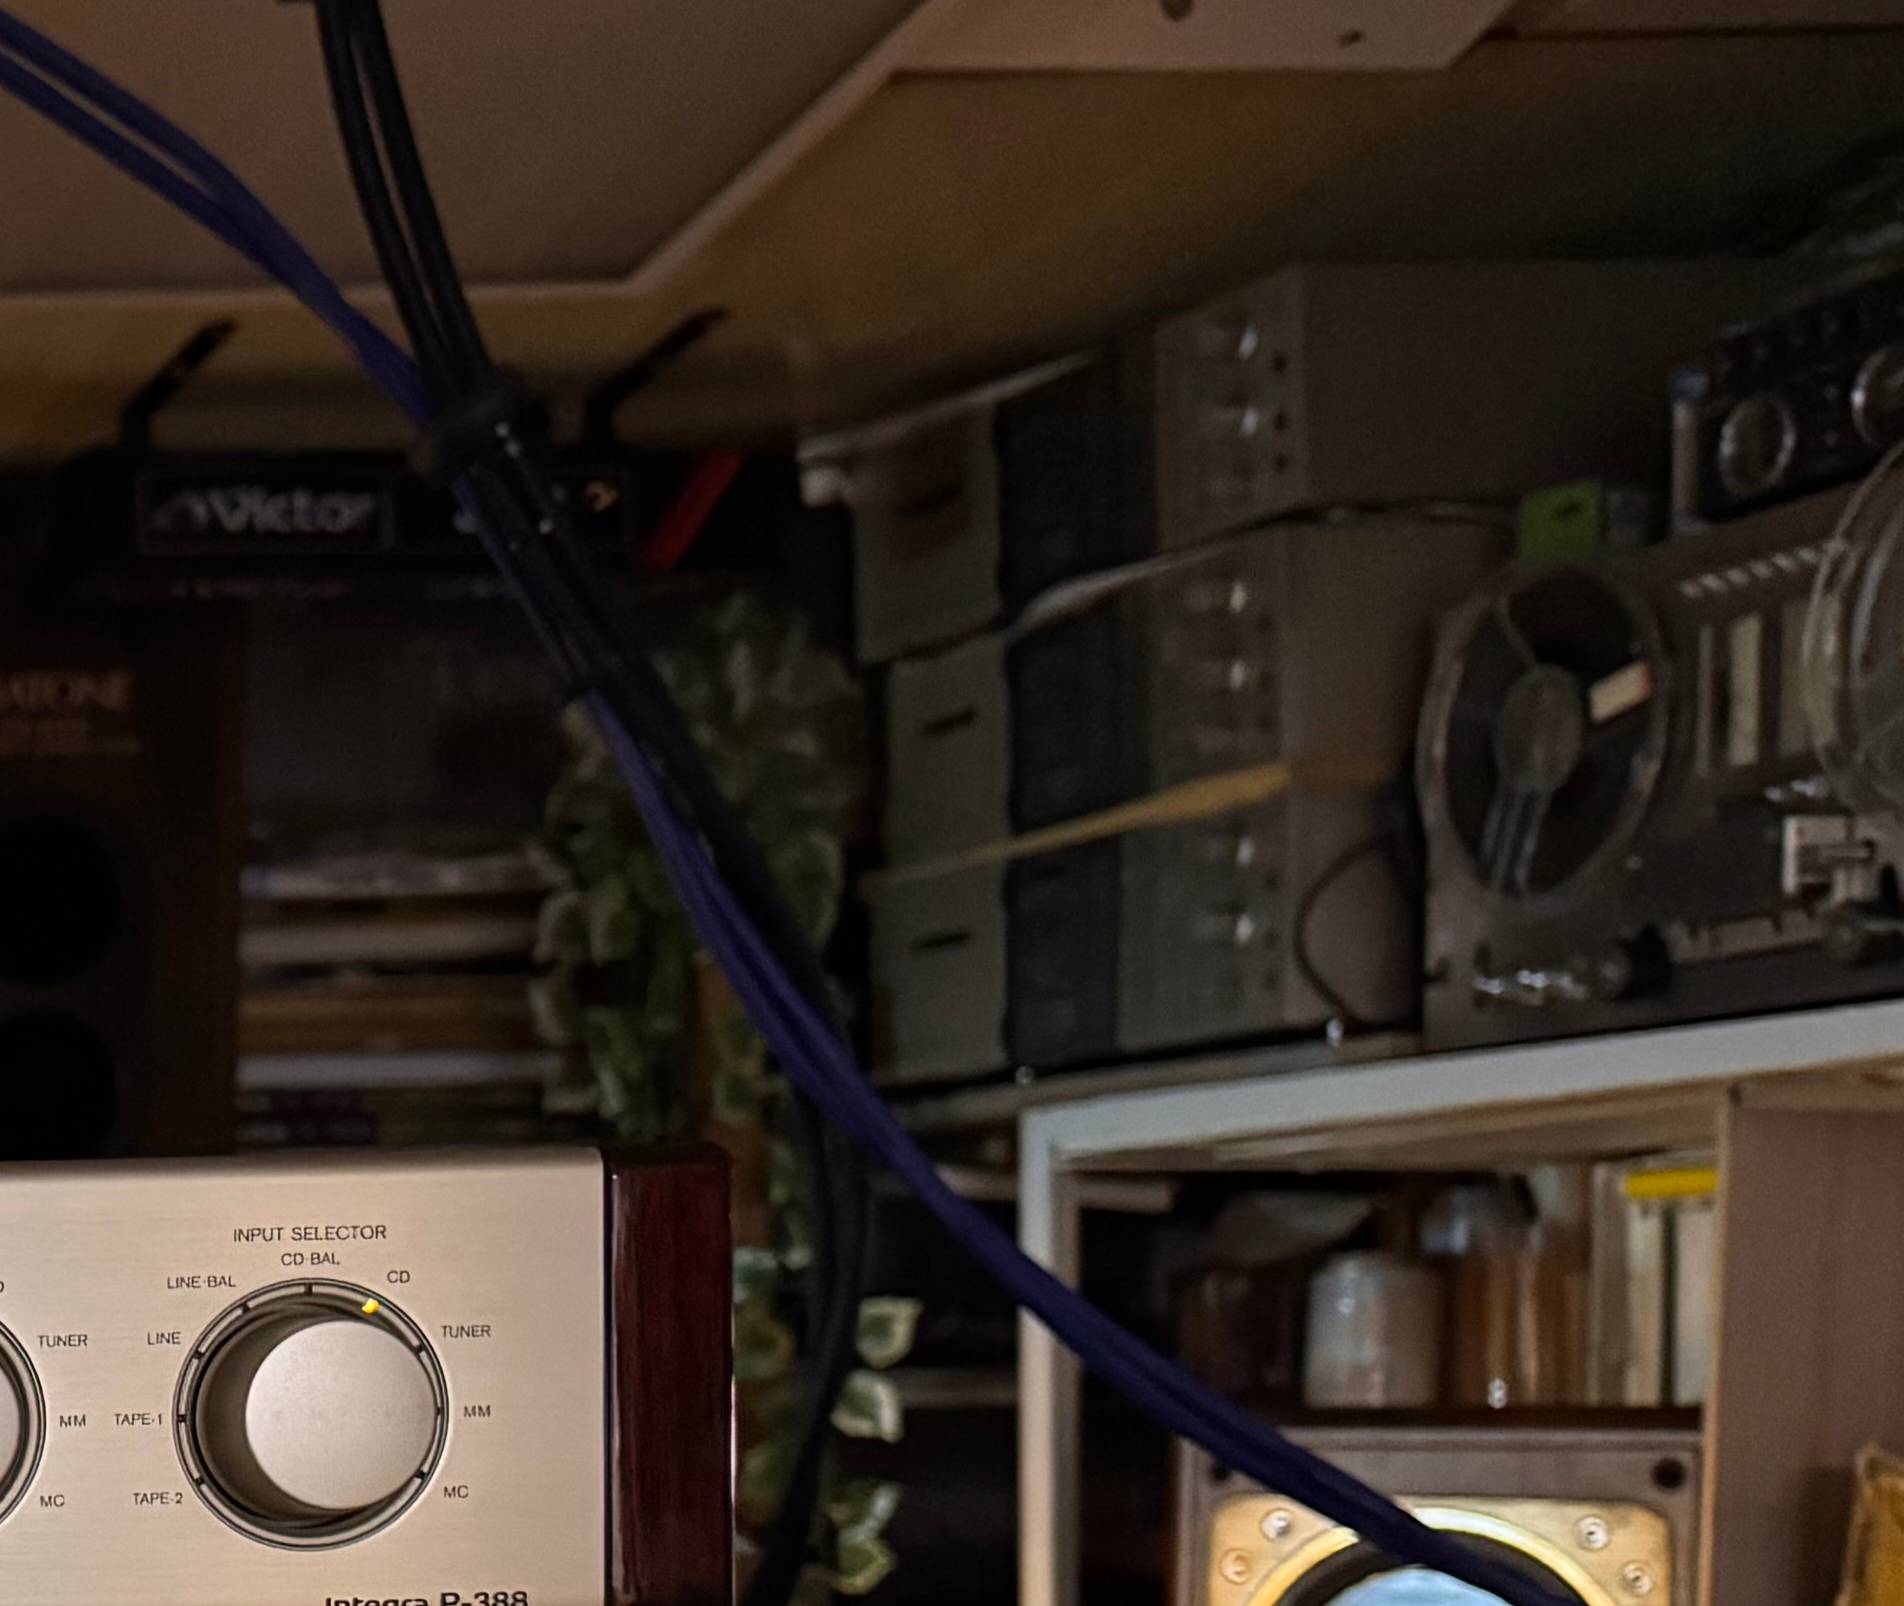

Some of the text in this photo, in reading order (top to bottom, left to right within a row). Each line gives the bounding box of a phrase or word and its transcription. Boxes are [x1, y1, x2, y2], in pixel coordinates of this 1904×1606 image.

[234, 1225, 387, 1242] INPUT SELECTOR
[387, 1270, 410, 1283] CD
[441, 1325, 491, 1338] TUNER
[37, 1334, 88, 1347] TUNER
[147, 1332, 181, 1345] LINE
[464, 1405, 490, 1418] MM
[59, 1415, 86, 1427] MM
[443, 1485, 468, 1498] MC
[40, 1495, 65, 1507] MC
